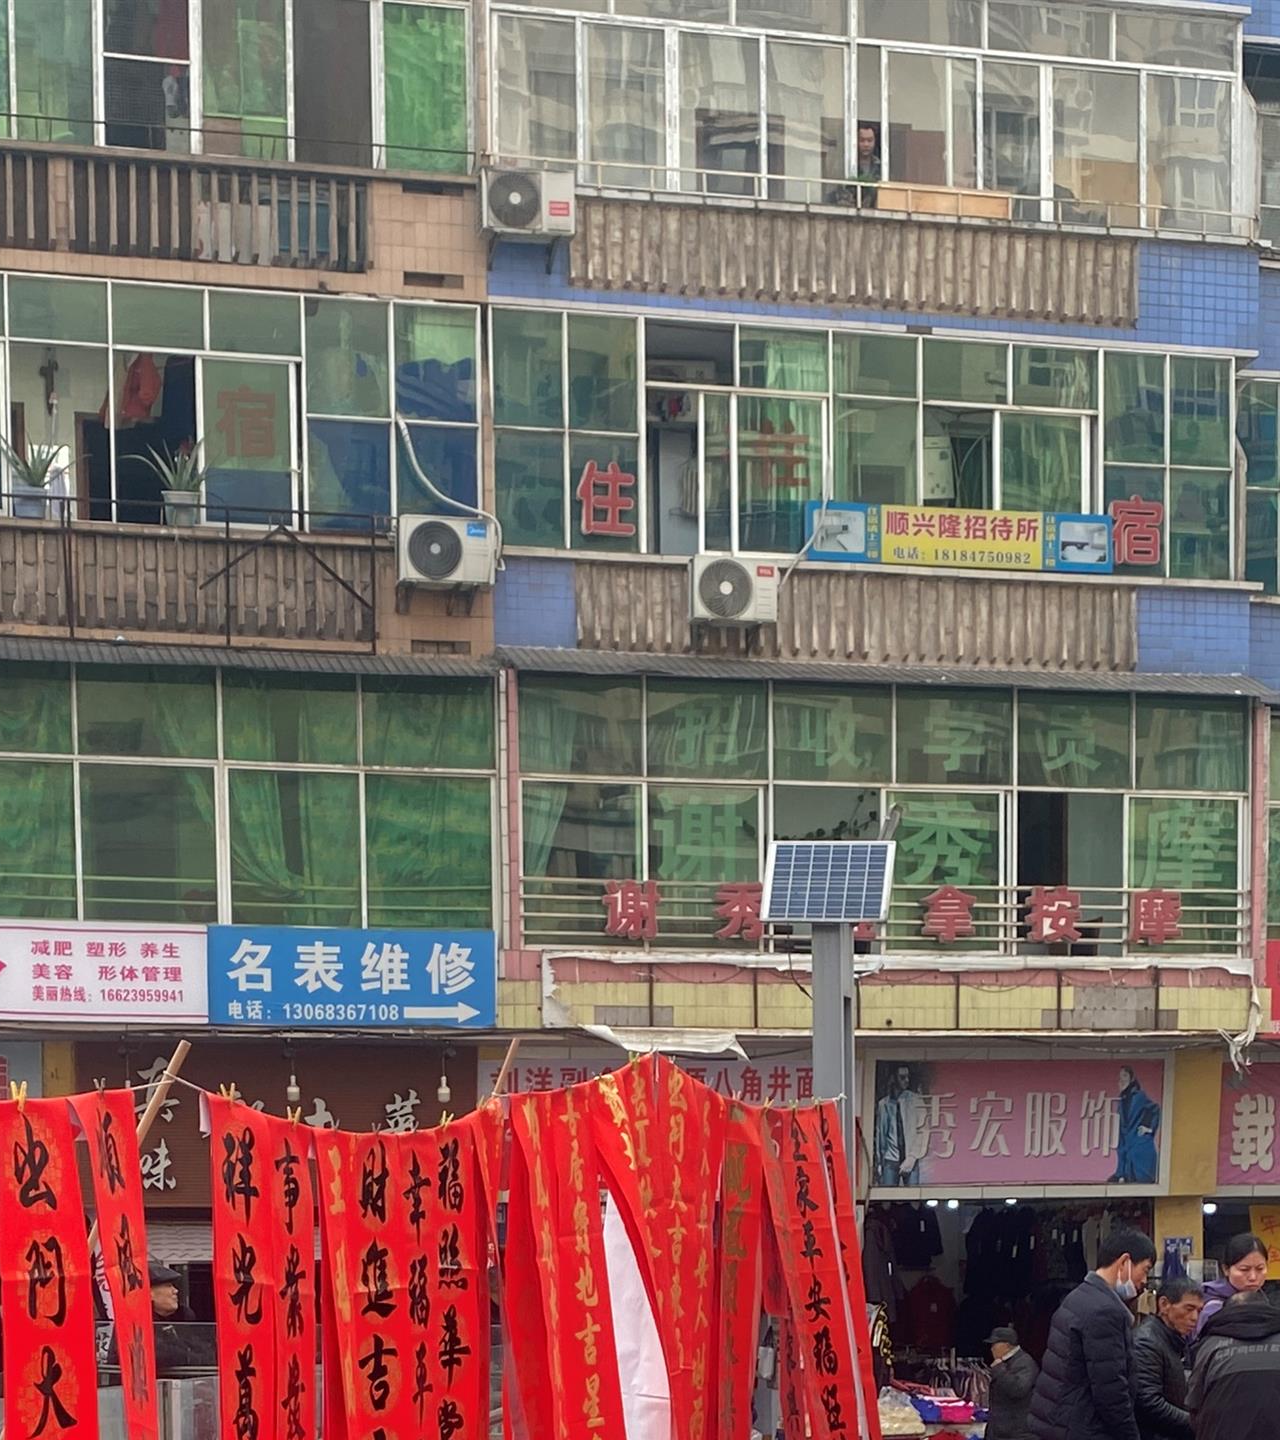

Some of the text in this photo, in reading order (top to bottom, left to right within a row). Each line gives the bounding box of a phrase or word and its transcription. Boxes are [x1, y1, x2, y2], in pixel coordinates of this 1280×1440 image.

[577, 460, 637, 537] 住
[884, 510, 1040, 543] 顺兴隆招待所
[1113, 494, 1163, 566] 宿
[602, 880, 1183, 943] 谢秀拿按摩
[31, 940, 181, 959] 减肥 塑形 养生
[31, 963, 183, 983] 美容 形体管理
[226, 939, 476, 995] 名表维修
[227, 1000, 400, 1022] 电话：13068367108
[916, 1094, 1122, 1160] 秀宏服饰
